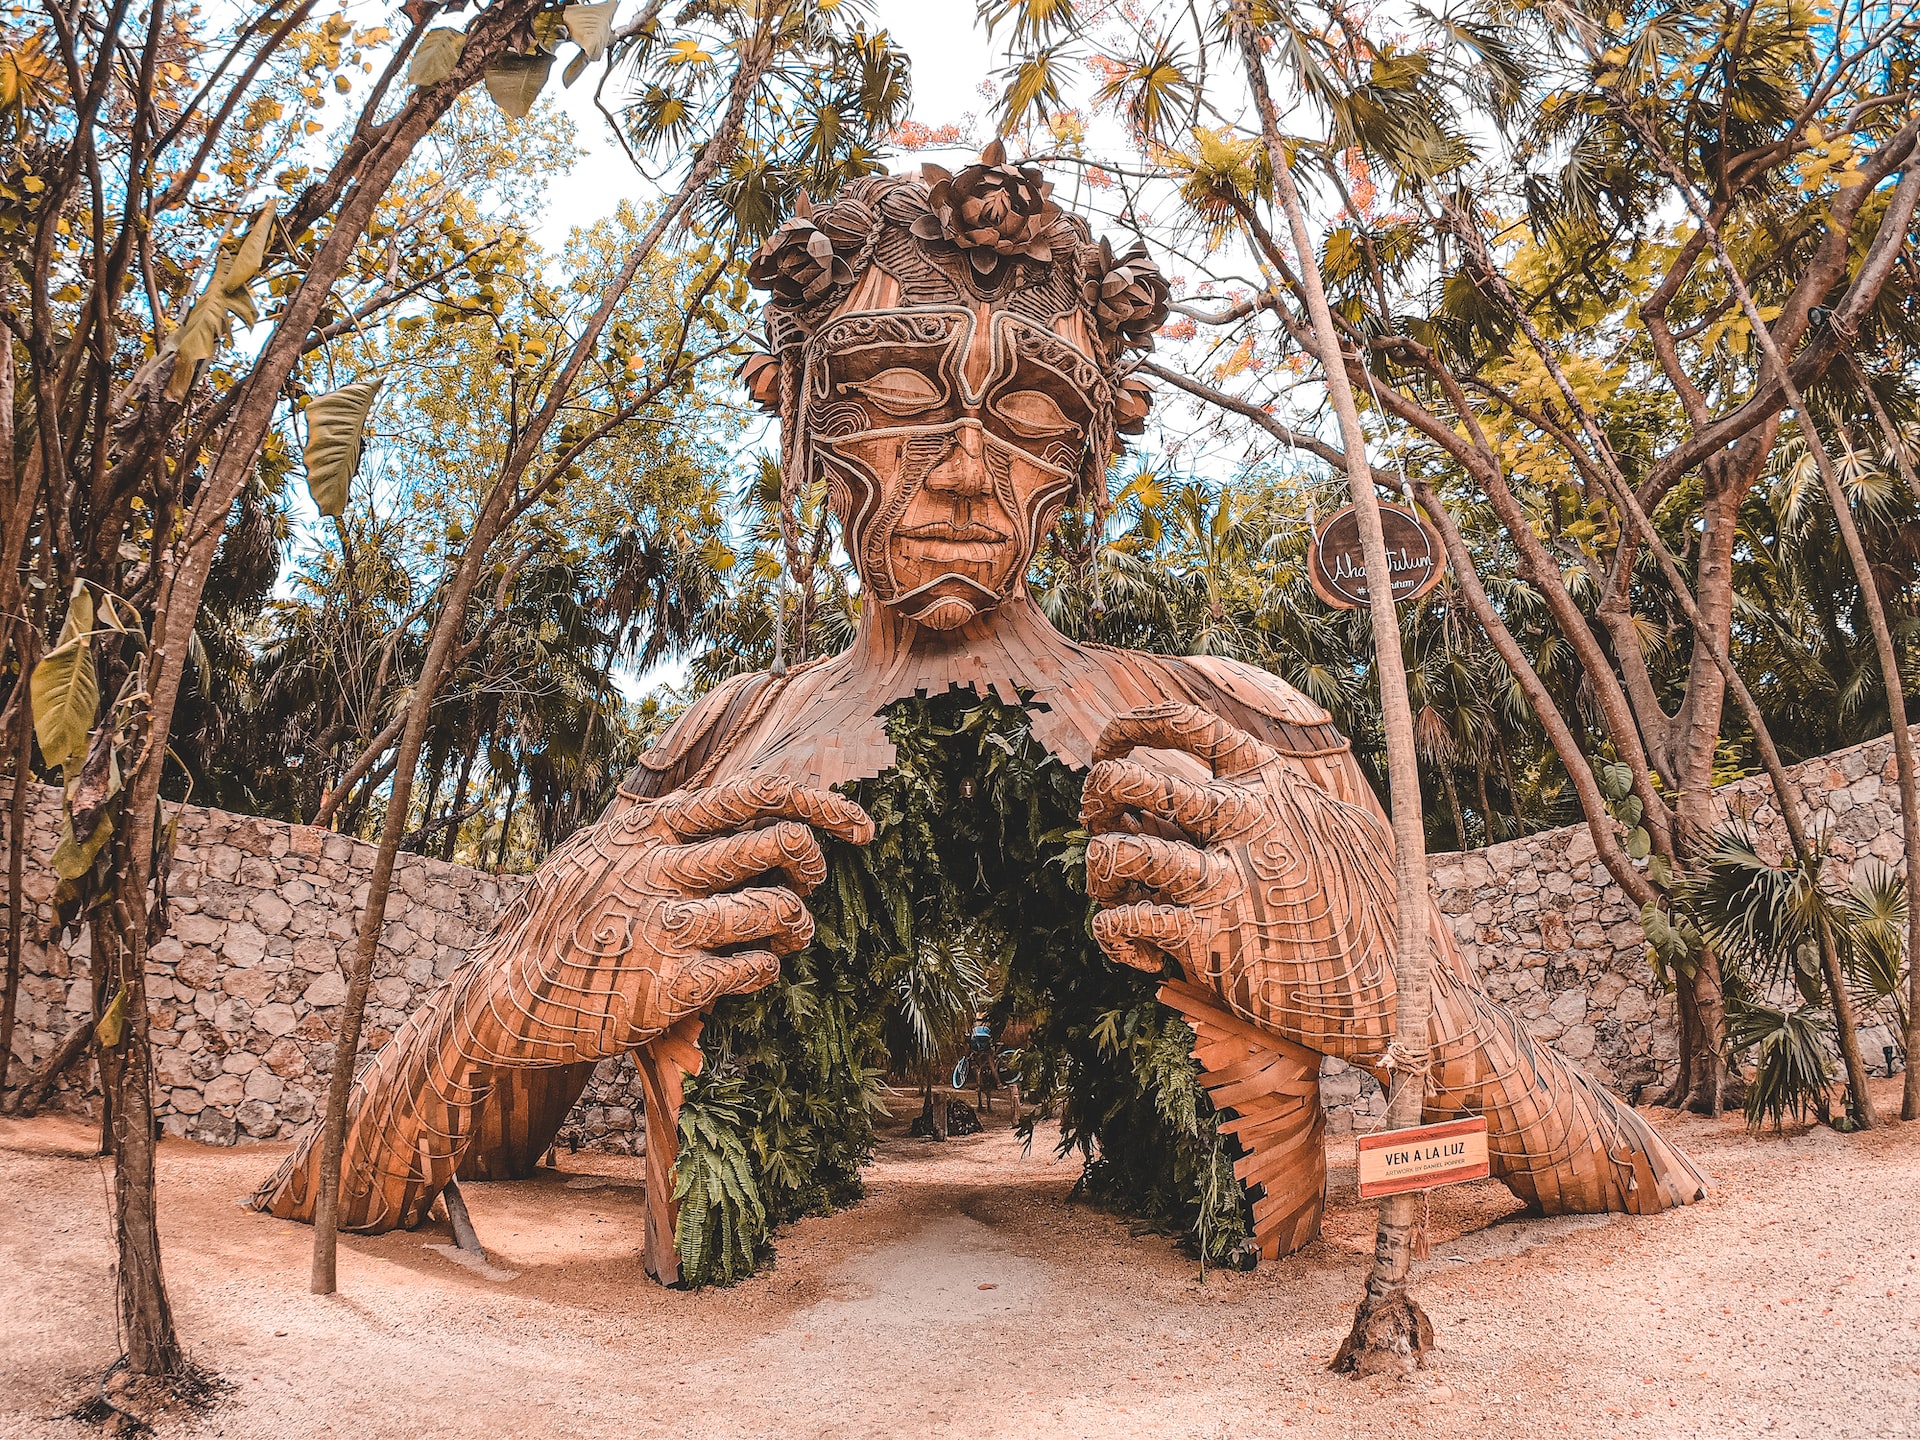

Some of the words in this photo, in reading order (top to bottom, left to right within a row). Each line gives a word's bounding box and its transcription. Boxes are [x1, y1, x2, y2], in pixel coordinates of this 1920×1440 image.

[1385, 1151, 1409, 1166] VEN
[1413, 1149, 1421, 1162] A
[1426, 1146, 1440, 1160] LA
[1444, 1142, 1465, 1157] LUZ
[1385, 1166, 1414, 1177] ARTWORK
[1423, 1162, 1443, 1170] DANIEL
[1444, 1158, 1465, 1167] POPPER
